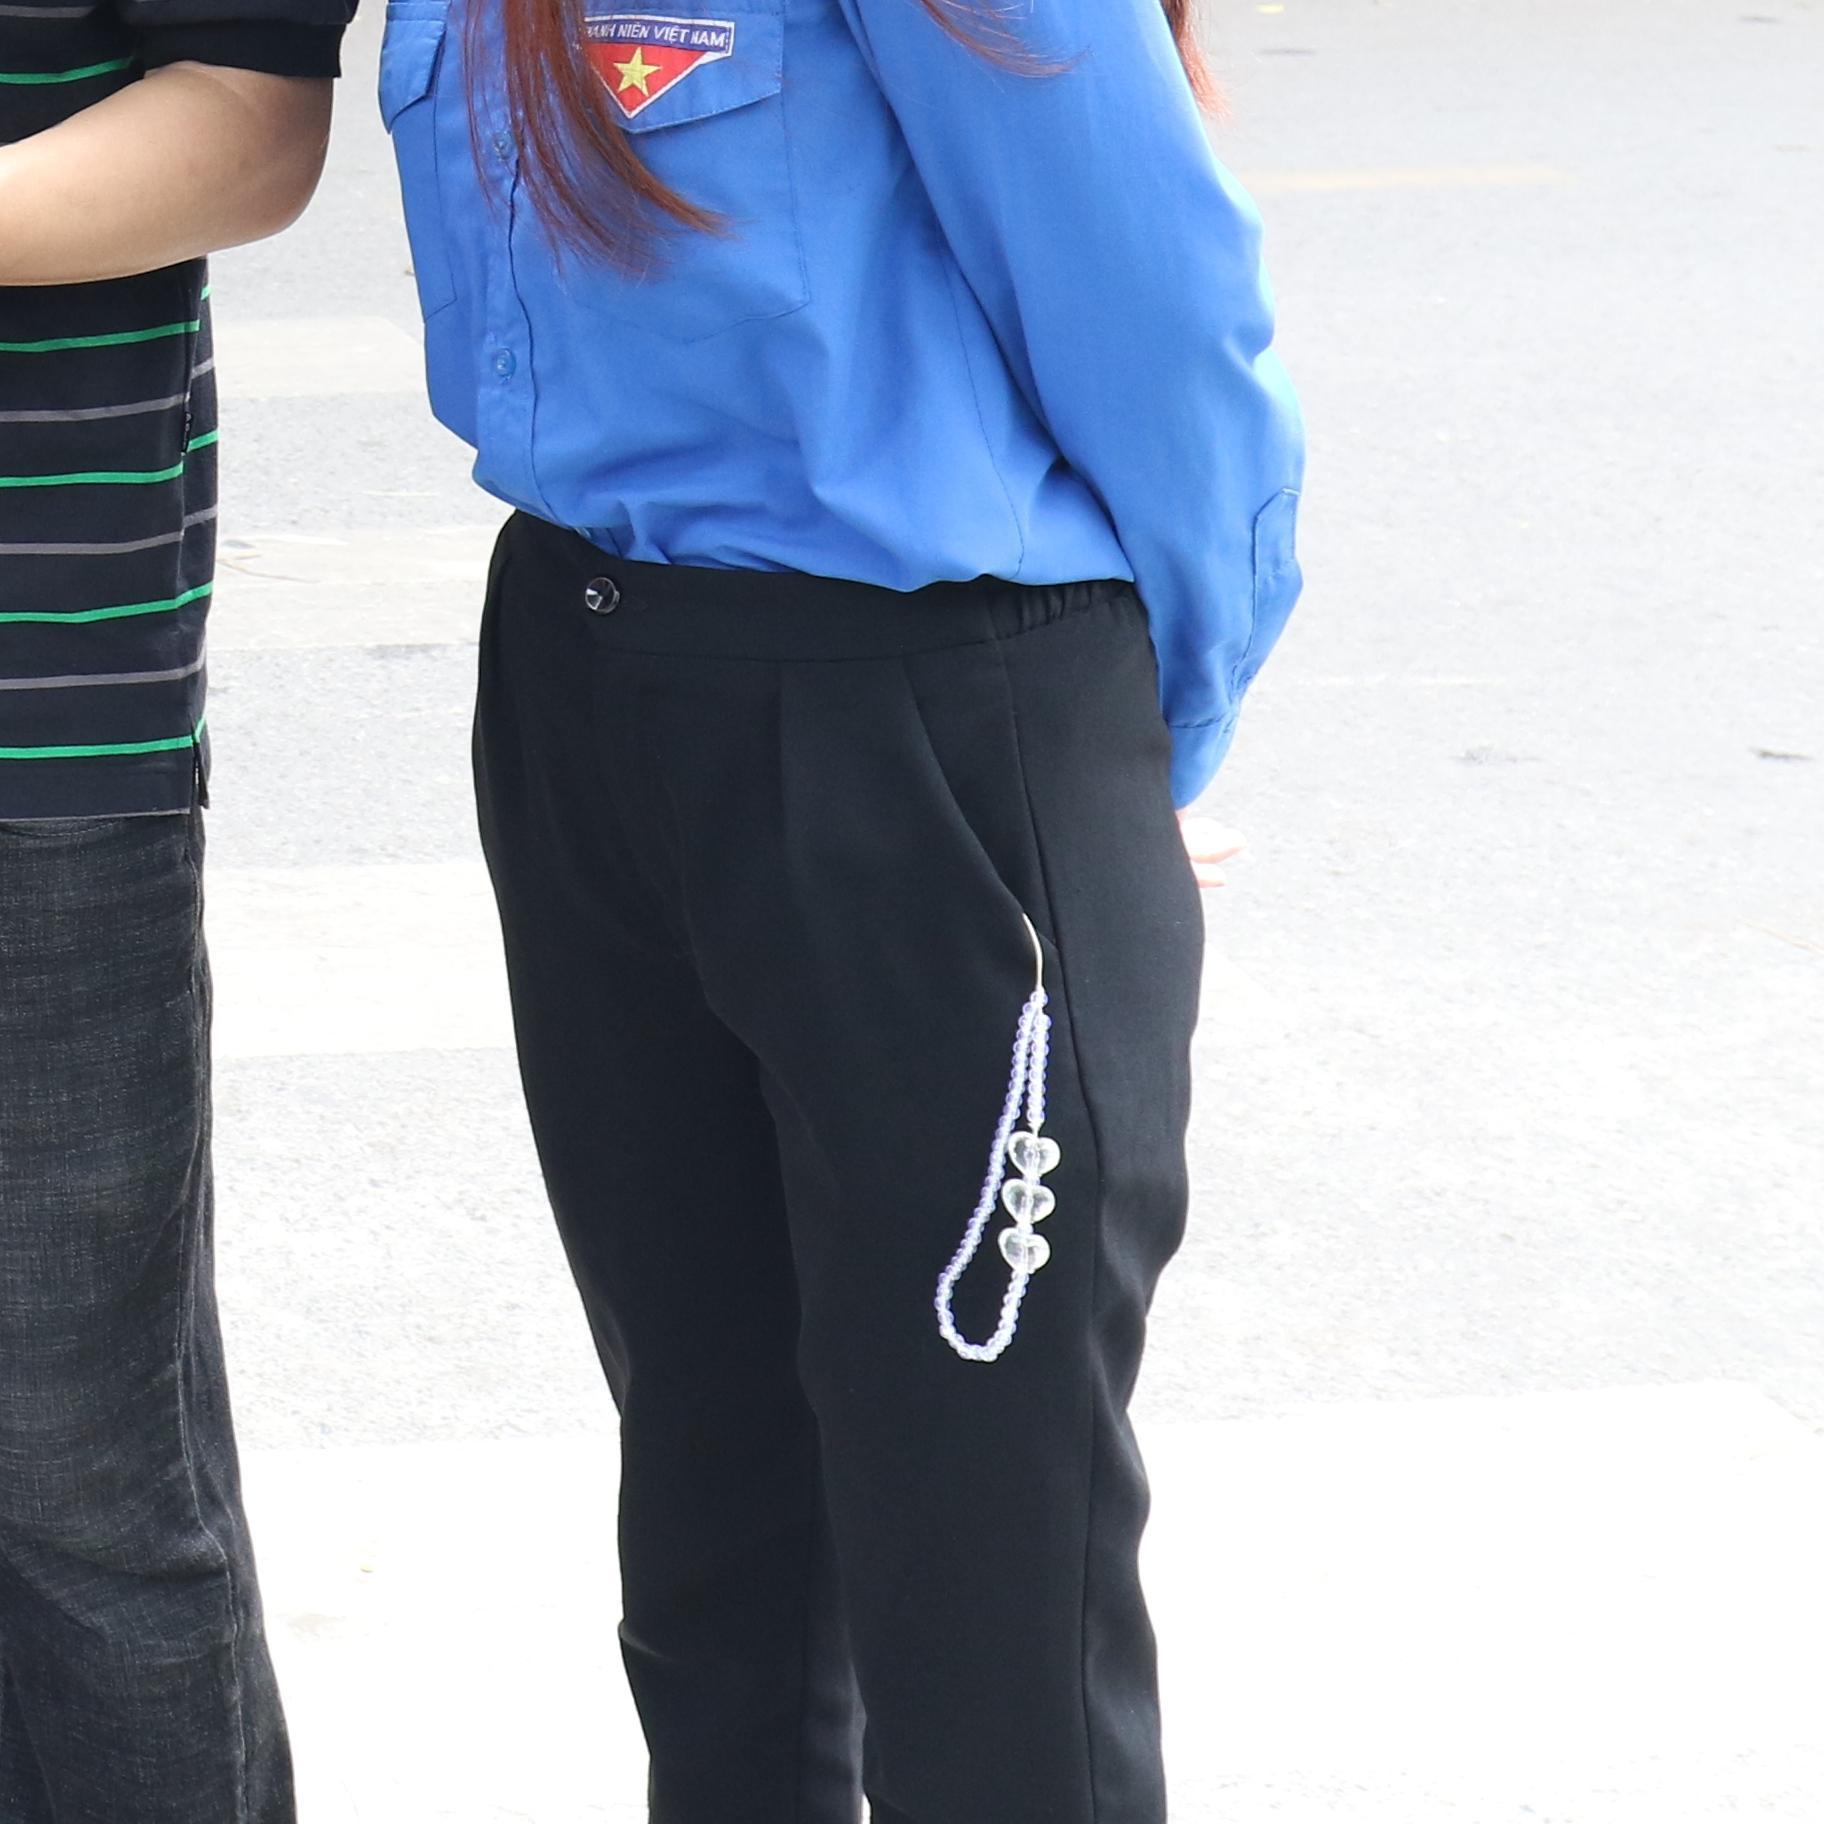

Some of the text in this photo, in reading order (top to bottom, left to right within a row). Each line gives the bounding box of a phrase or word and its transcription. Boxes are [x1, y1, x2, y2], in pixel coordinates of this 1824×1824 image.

[617, 21, 649, 39] NIÊN
[654, 24, 690, 46] VIỆT
[691, 30, 727, 48] NAM
